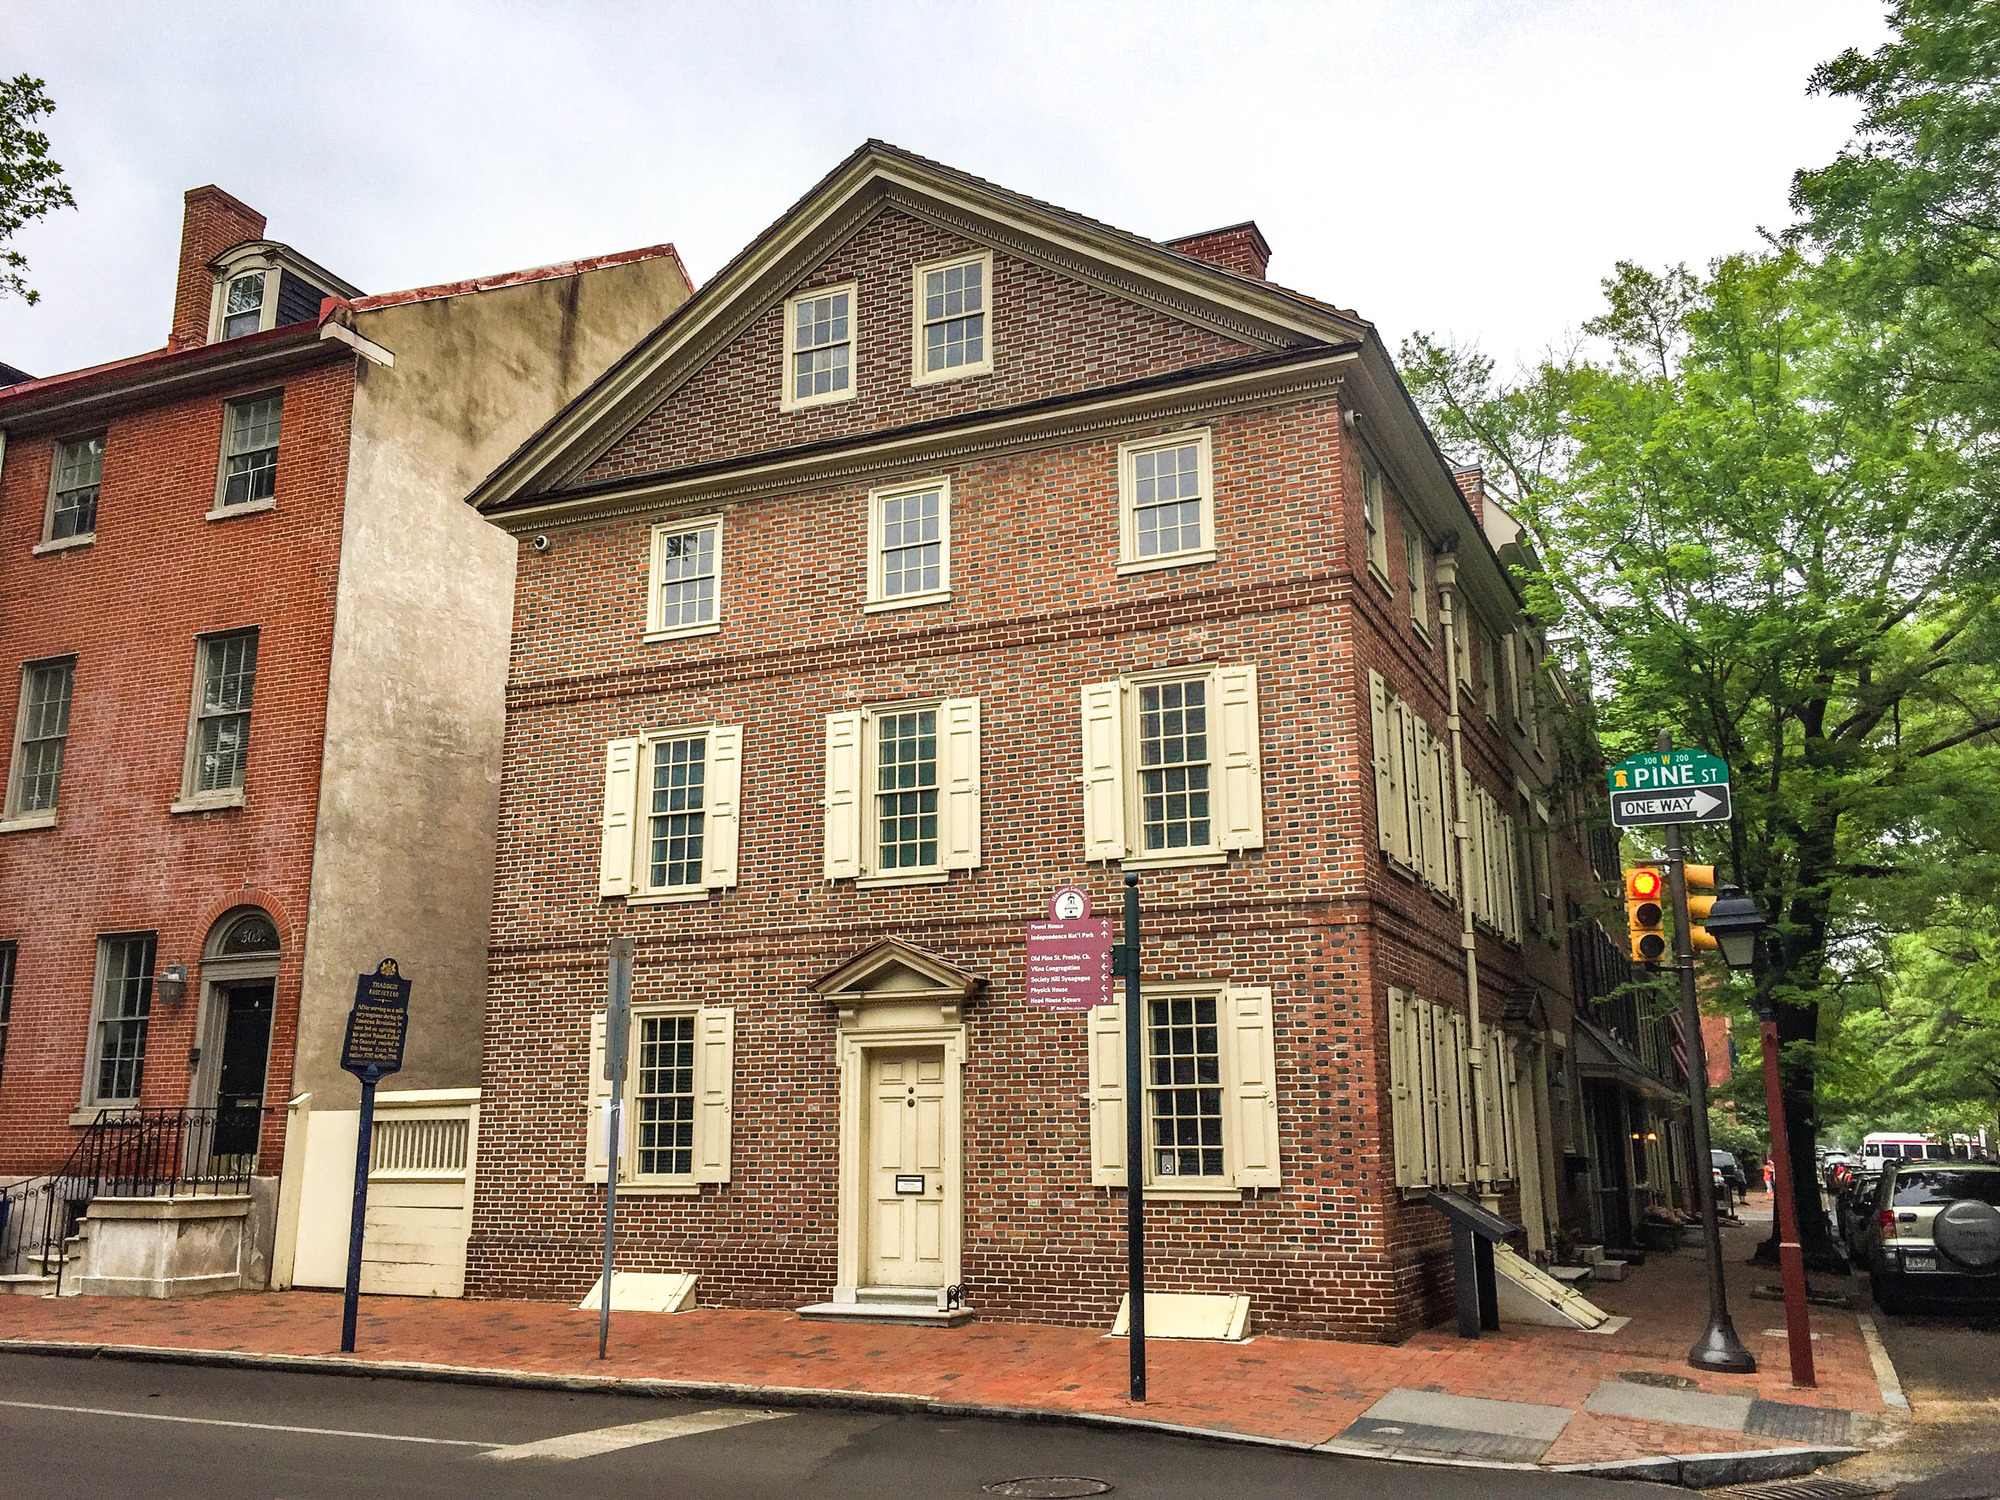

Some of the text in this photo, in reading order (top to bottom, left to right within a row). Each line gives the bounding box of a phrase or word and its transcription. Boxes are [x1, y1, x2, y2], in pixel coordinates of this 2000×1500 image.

[1644, 754, 1689, 765] 300 W 200
[1634, 764, 1717, 787] PINE ST
[1625, 798, 1693, 814] ONE WAY
